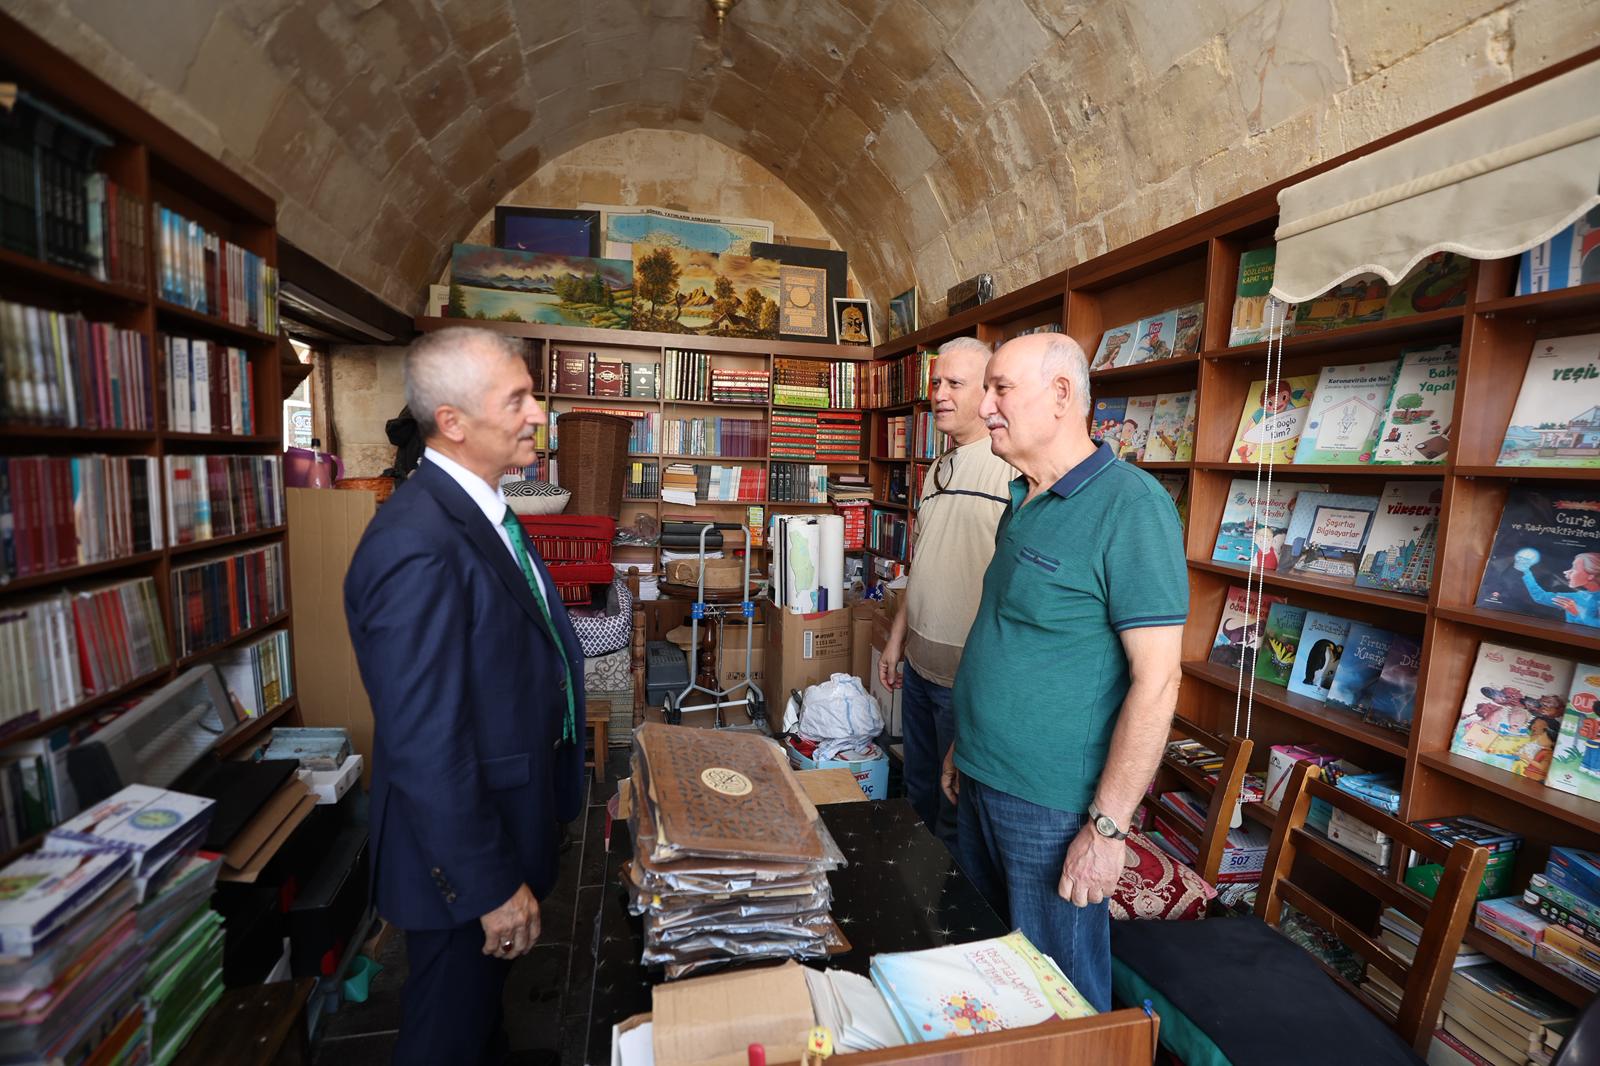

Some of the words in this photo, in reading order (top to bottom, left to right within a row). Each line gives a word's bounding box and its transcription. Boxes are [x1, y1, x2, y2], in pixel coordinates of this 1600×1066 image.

[1387, 501, 1431, 517] YÜKSEK
[1511, 522, 1522, 530] ve
[1556, 512, 1597, 528] Curie
